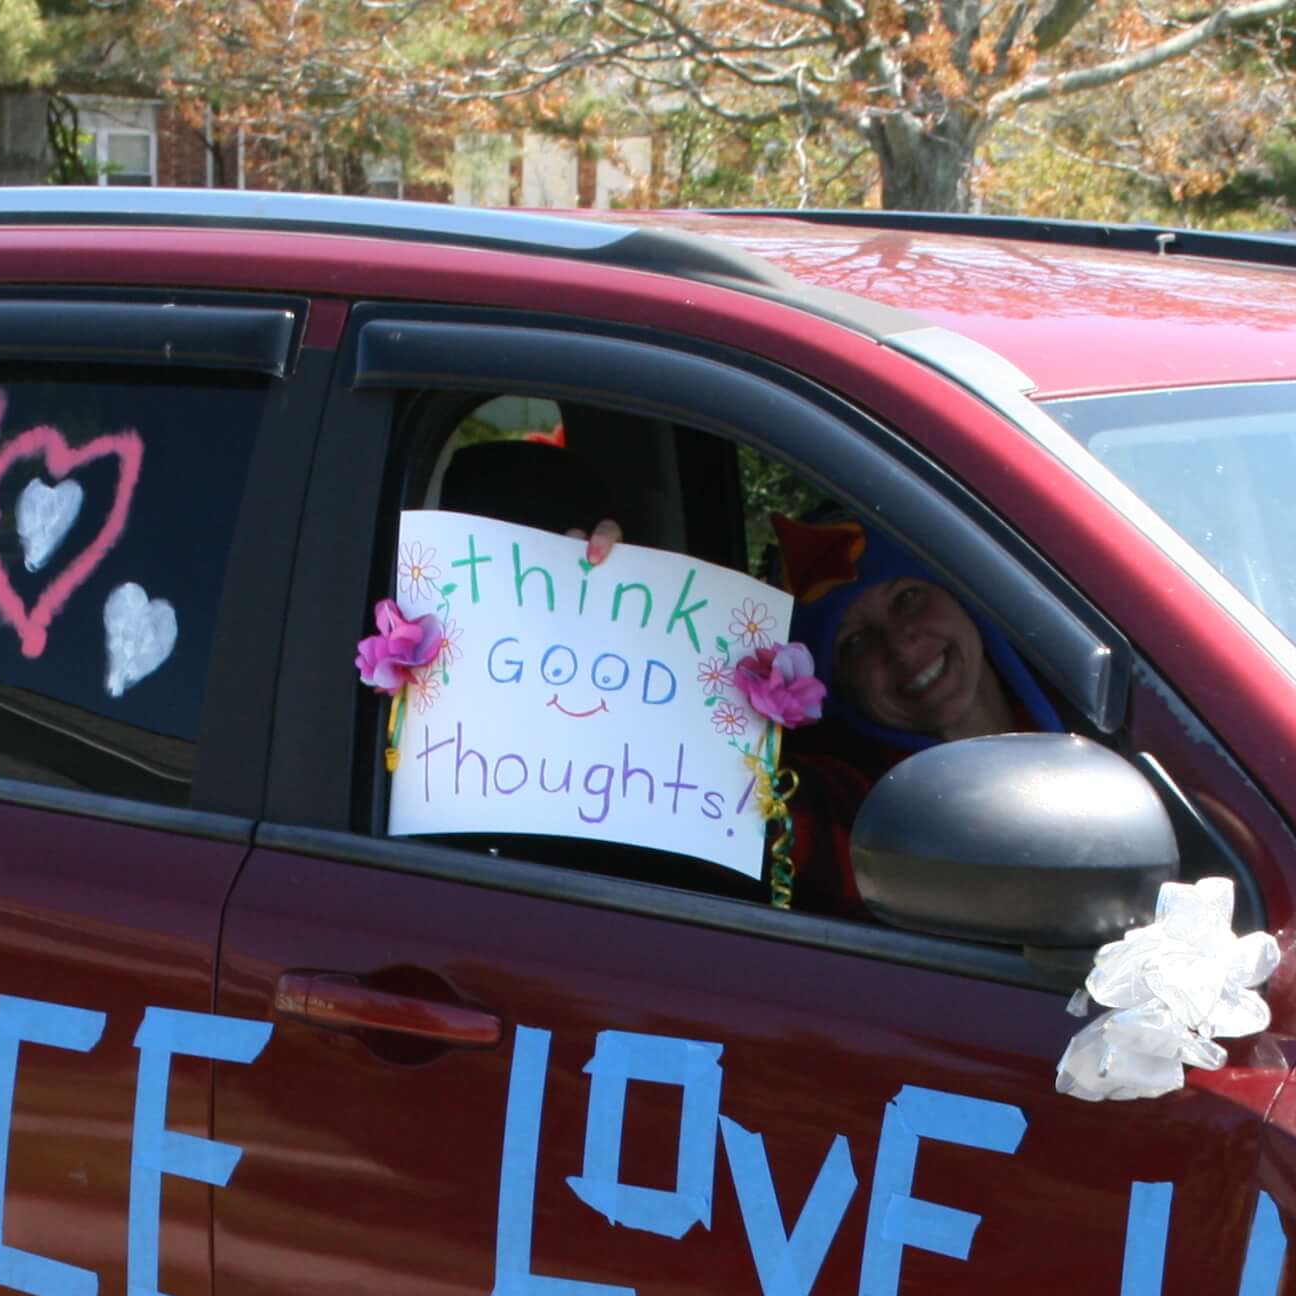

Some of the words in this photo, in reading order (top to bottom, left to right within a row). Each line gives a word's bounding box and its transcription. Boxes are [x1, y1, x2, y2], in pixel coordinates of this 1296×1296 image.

[452, 534, 708, 653] think
[488, 637, 677, 705] GOOD
[416, 722, 757, 838] thoughts!
